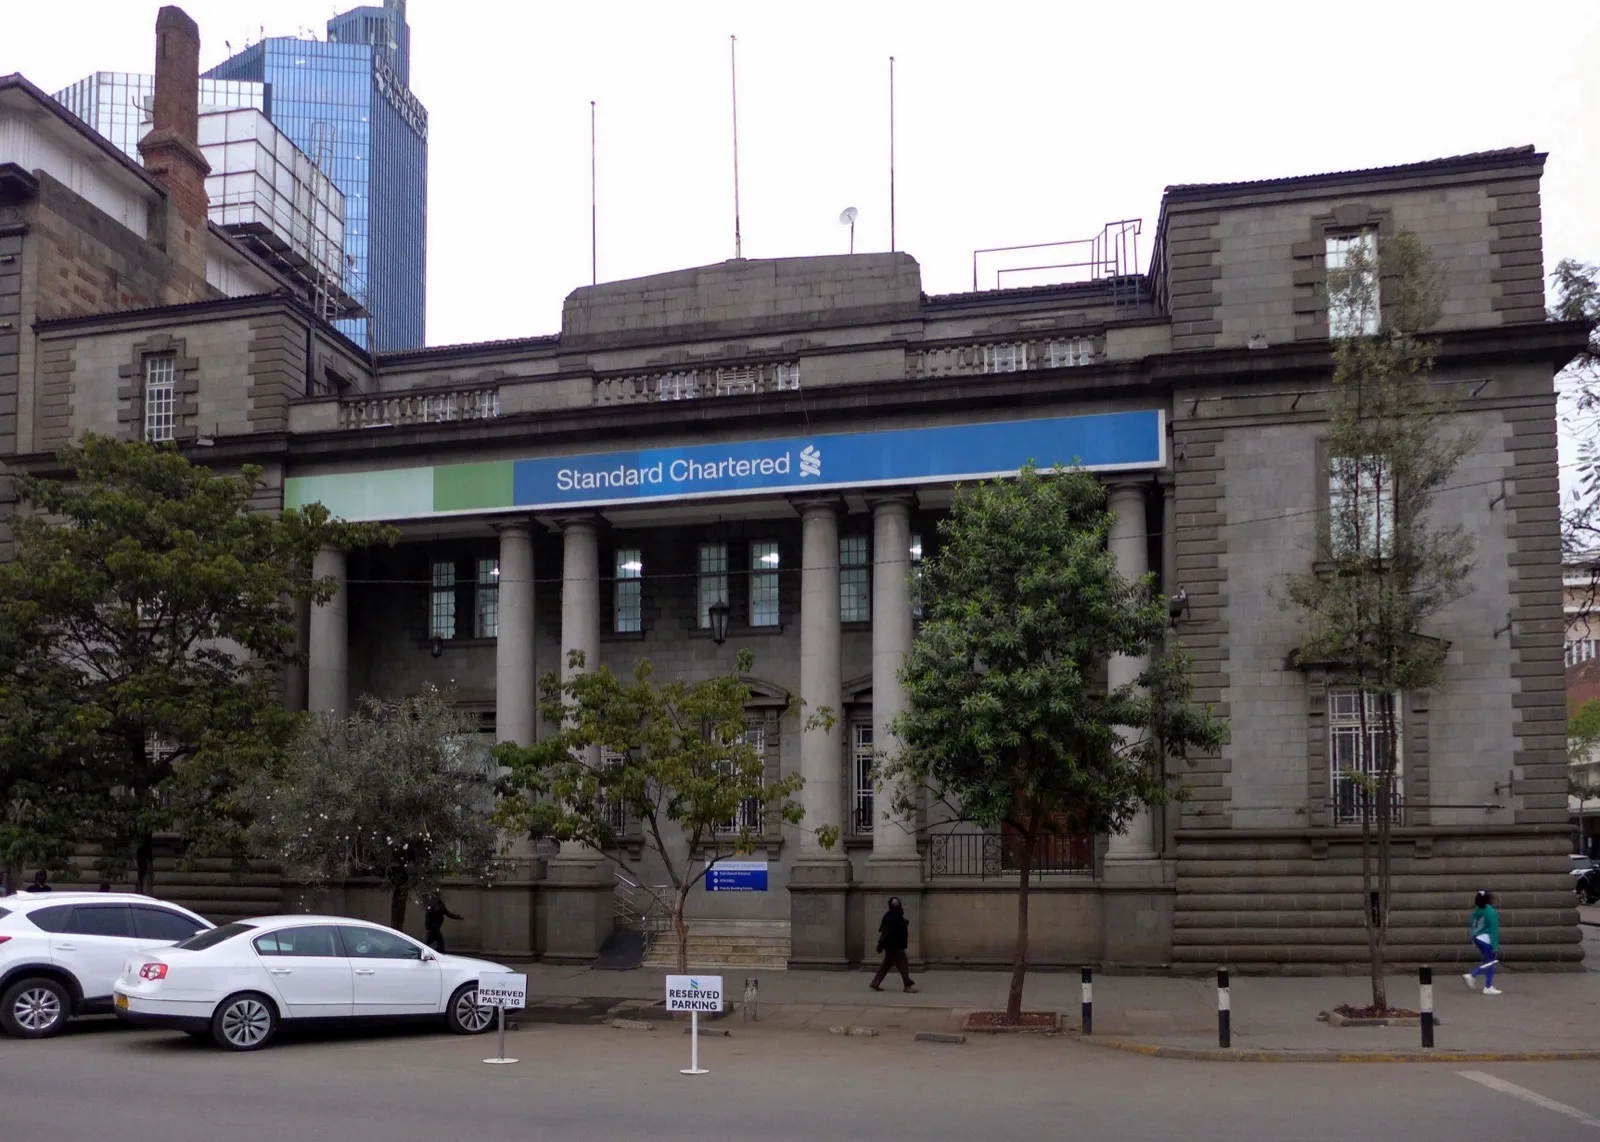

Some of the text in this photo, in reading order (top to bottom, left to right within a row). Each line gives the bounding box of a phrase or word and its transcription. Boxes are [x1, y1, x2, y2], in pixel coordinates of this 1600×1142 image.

[386, 87, 428, 139] AFRICA
[557, 452, 790, 490] Standard Chartered
[479, 989, 524, 998] RESERVED
[669, 989, 720, 999] RESERVED
[671, 1000, 718, 1010] PARKING
